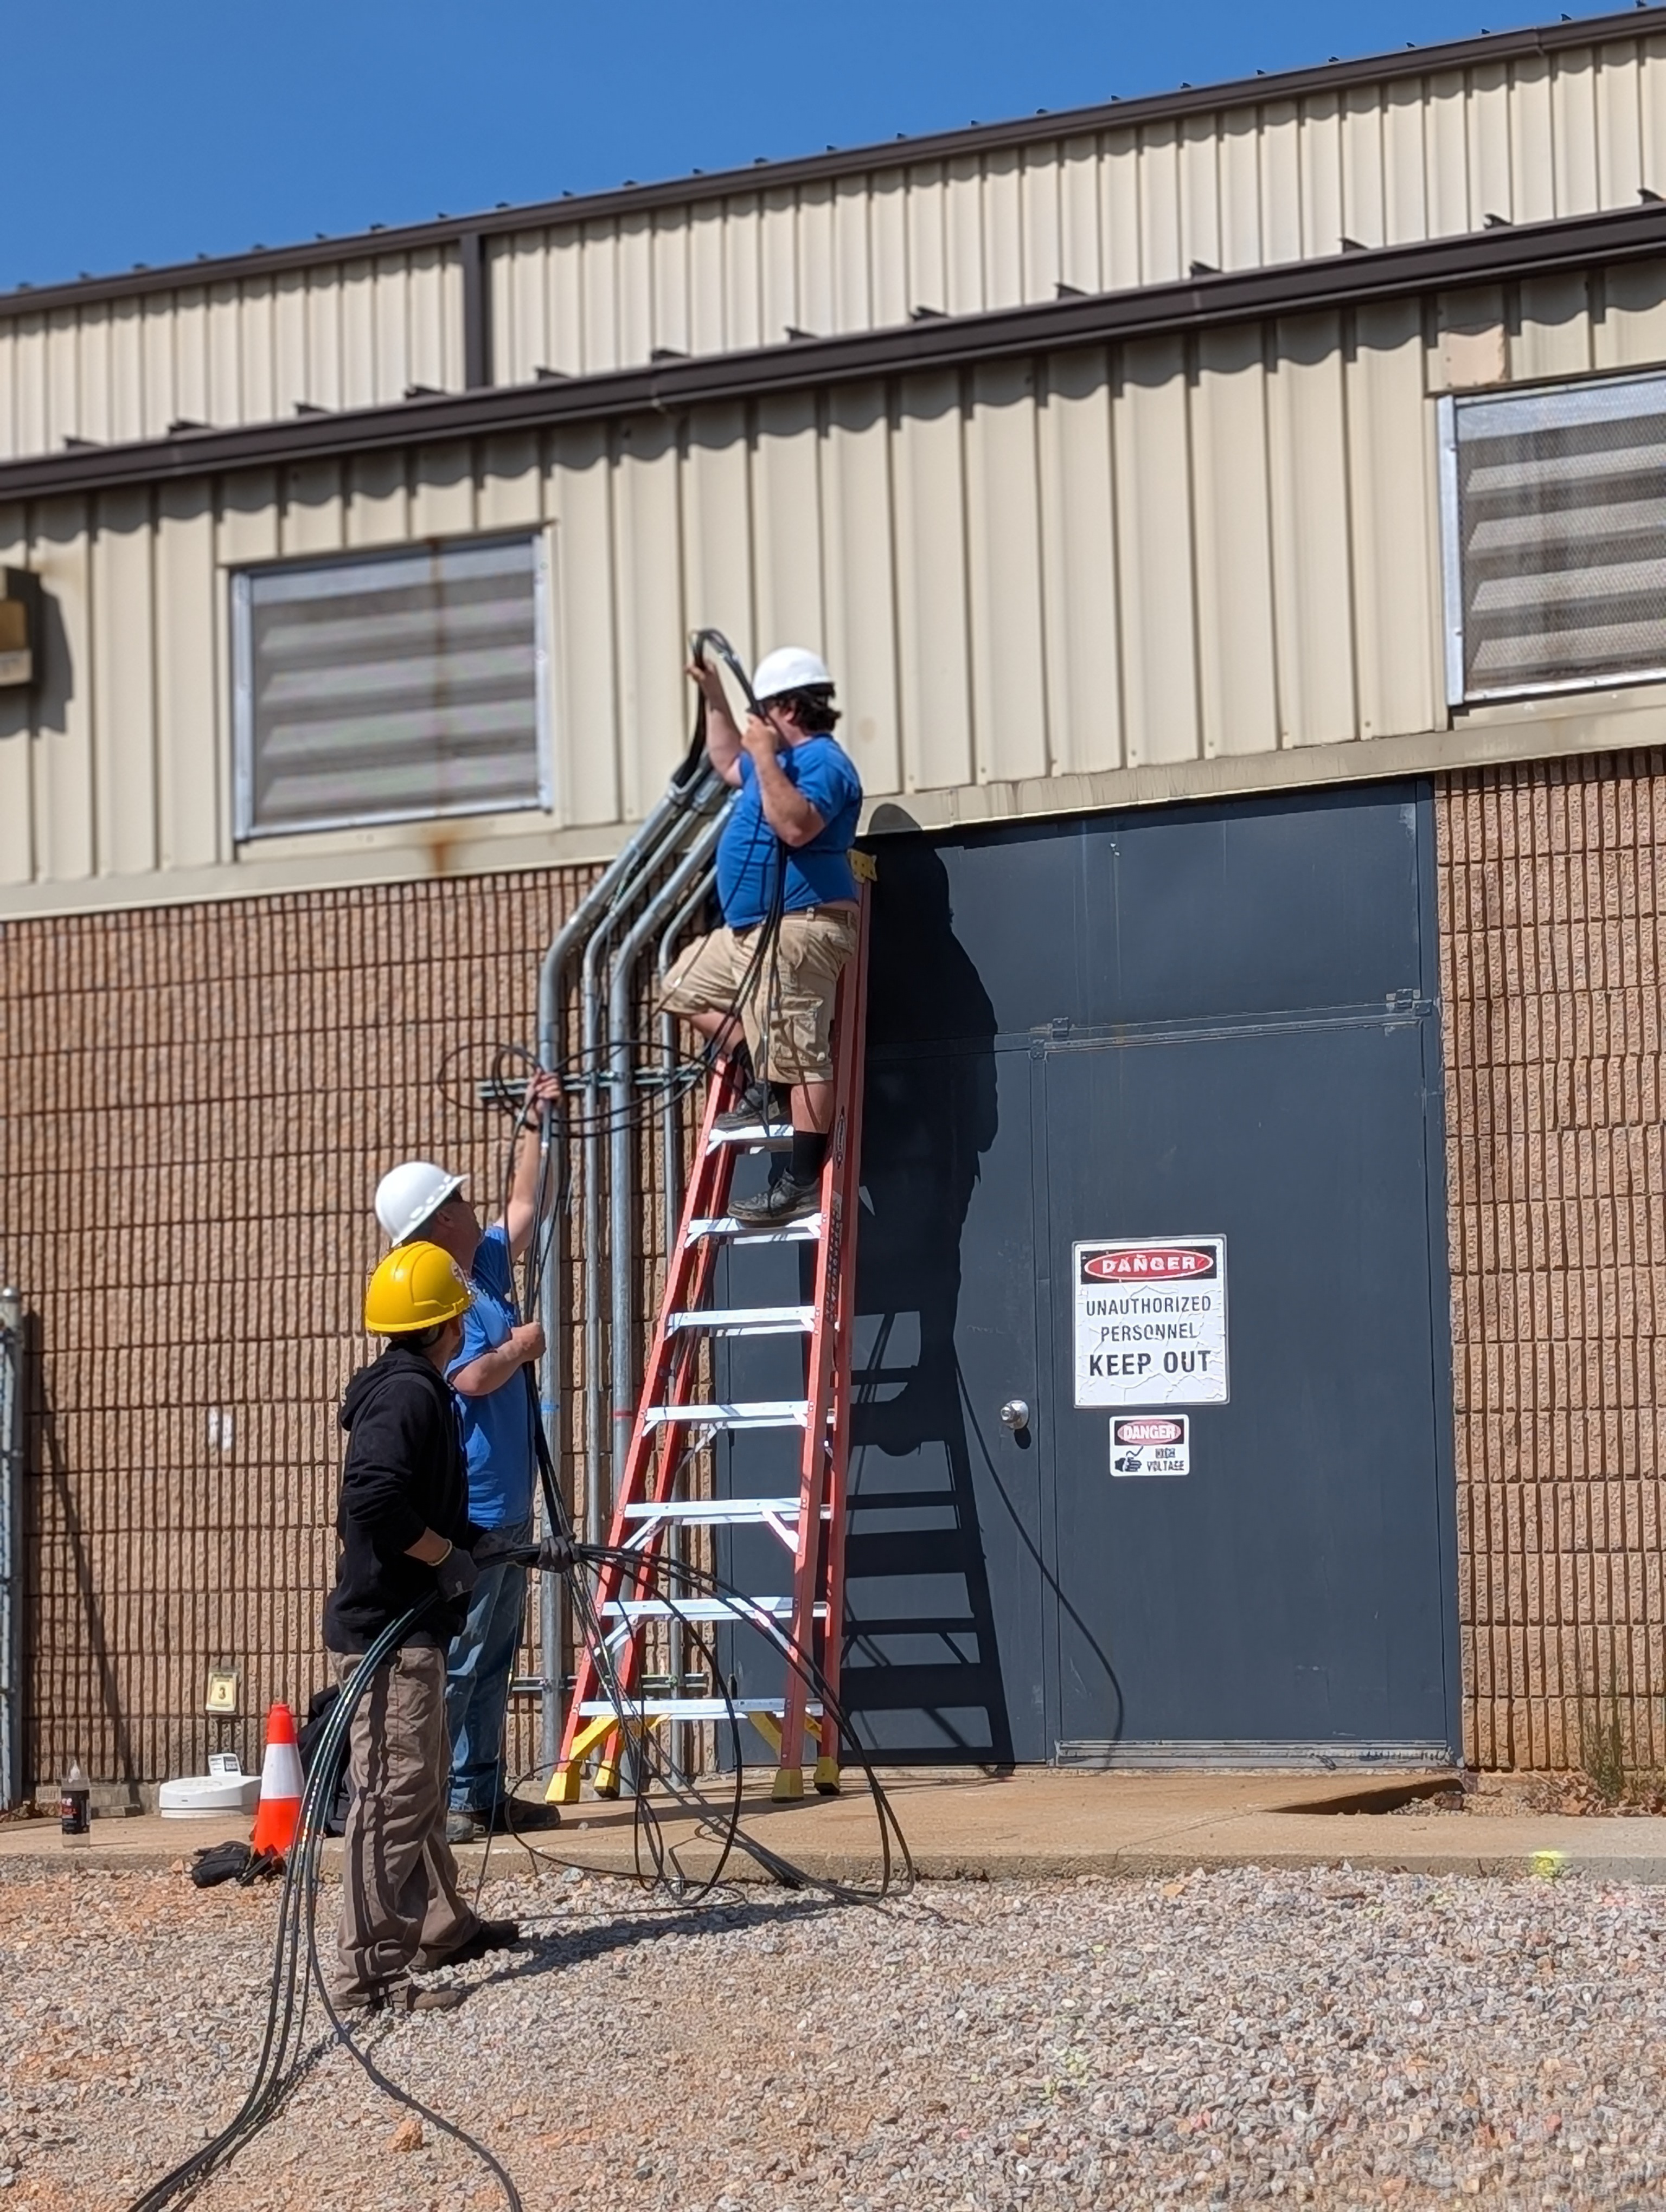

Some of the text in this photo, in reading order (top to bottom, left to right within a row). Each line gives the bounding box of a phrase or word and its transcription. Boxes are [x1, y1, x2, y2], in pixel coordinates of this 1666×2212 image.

[1102, 1256, 1196, 1274] DANGER
[1086, 1295, 1211, 1316] UNAUTHORIZED
[1101, 1322, 1198, 1342] PERSONNEL
[1090, 1350, 1211, 1376] KEEP OUT
[1123, 1424, 1176, 1439] DANGER
[218, 1687, 226, 1700] 3
